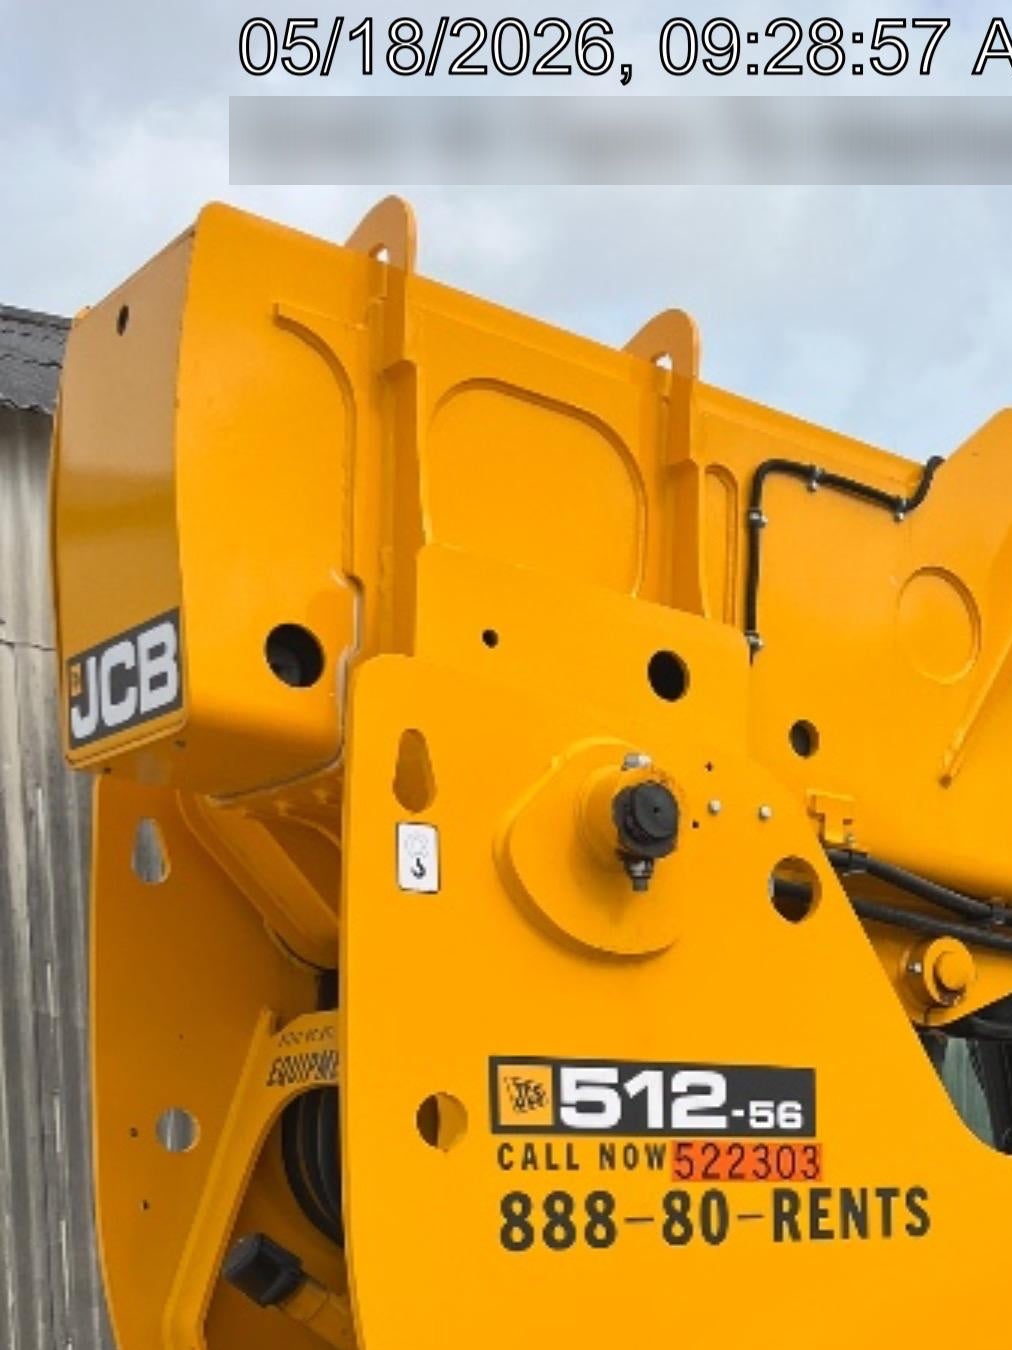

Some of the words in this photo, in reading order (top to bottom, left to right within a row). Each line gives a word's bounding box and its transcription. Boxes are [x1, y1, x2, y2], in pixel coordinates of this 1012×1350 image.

[71, 621, 179, 739] JCB
[560, 1067, 803, 1129] 512-56
[497, 1143, 580, 1171] CALL
[599, 1143, 667, 1171] NOW
[673, 1141, 821, 1180] 522303
[499, 1187, 931, 1252] 888-80-RENTS
